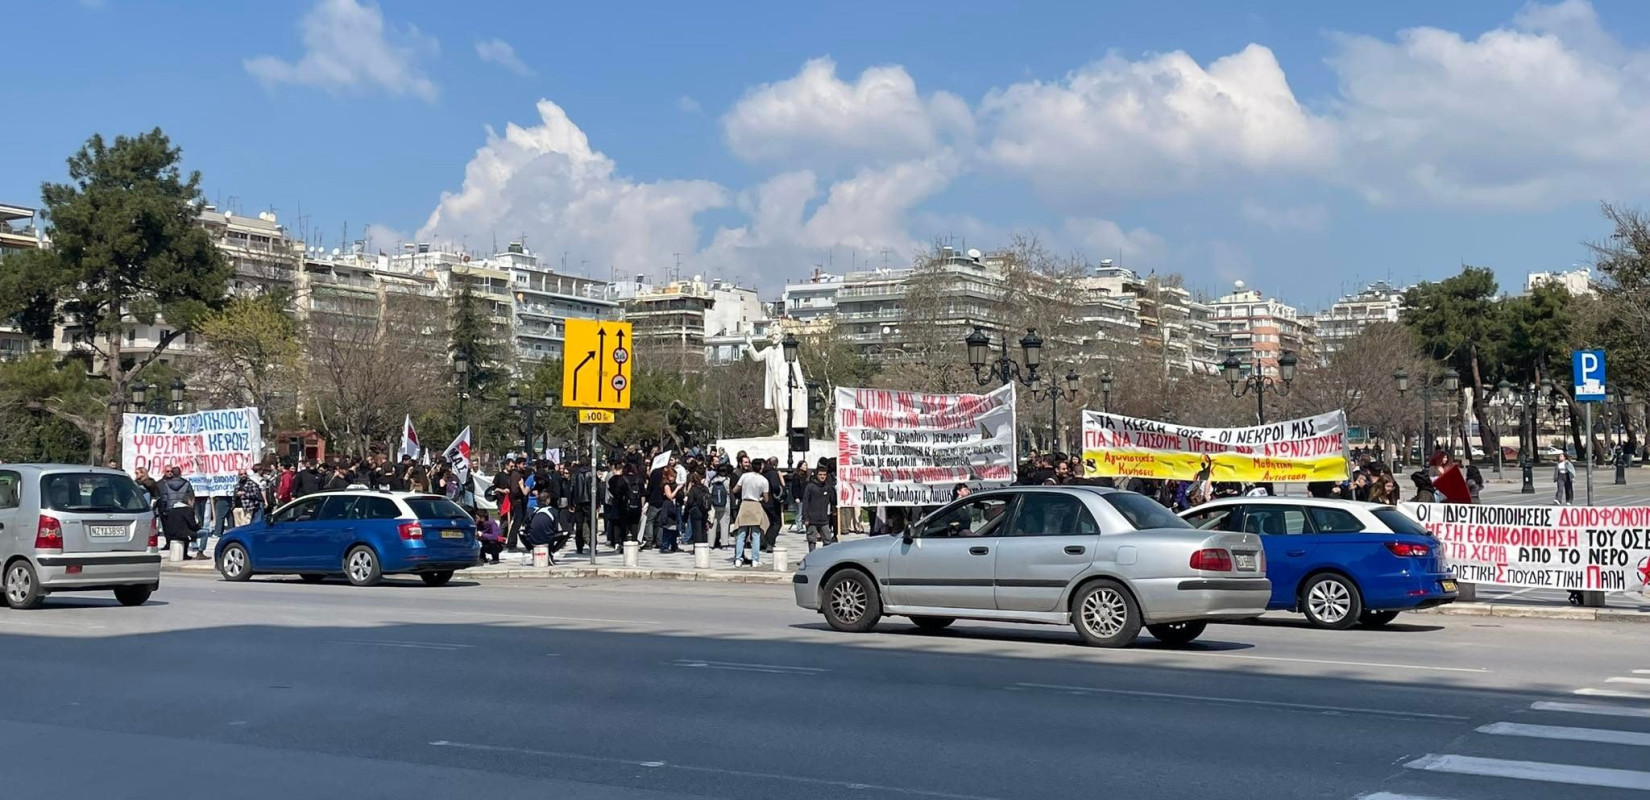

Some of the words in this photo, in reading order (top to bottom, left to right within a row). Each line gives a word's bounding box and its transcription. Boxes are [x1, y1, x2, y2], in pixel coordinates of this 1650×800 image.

[1582, 353, 1598, 382] P
[135, 415, 166, 434] ΜΑΣ
[1097, 415, 1115, 429] ΤΑ
[1122, 417, 1166, 434] ΚΕΡΔΗ
[1176, 427, 1203, 439] ΤΟΥΣ
[1219, 430, 1232, 444] ΟΙ
[1236, 424, 1284, 444] ΝΕΚΡΟΙ
[1292, 419, 1316, 440] ΜΑΣ
[1085, 431, 1106, 448] ΓΙΑ
[1112, 431, 1131, 447] ΝΑ
[1135, 432, 1182, 450] ΖΗΣΟΥΜΕ
[1264, 432, 1343, 457] ΑΓΩΝΙΣΤΟΥΜΕ
[1417, 504, 1431, 522] ΟΙ
[1443, 505, 1552, 527] ΙΔΙΩΤΙΚΟΠΟΙΗΣΕΙΣ
[1425, 523, 1463, 541] ΜΕΣΗ
[1467, 525, 1578, 547] ΕΘΝΙΚΟΠΟΙΗΣΗ
[1586, 529, 1617, 547] ΤΟΥ
[1621, 528, 1650, 550] ΟΣΕ
[1450, 542, 1467, 559] ΤΑ
[1471, 544, 1507, 562] ΧΕΡΙΑ
[1518, 547, 1551, 563] ΑΠΟ
[1559, 548, 1580, 565] ΤΟ
[1588, 548, 1629, 566] ΝΕΡΟ
[1496, 563, 1583, 588] ΣΠΟΥΔΑΣΤΙΚΗ
[1587, 565, 1626, 591] ΠΑΛΗ
